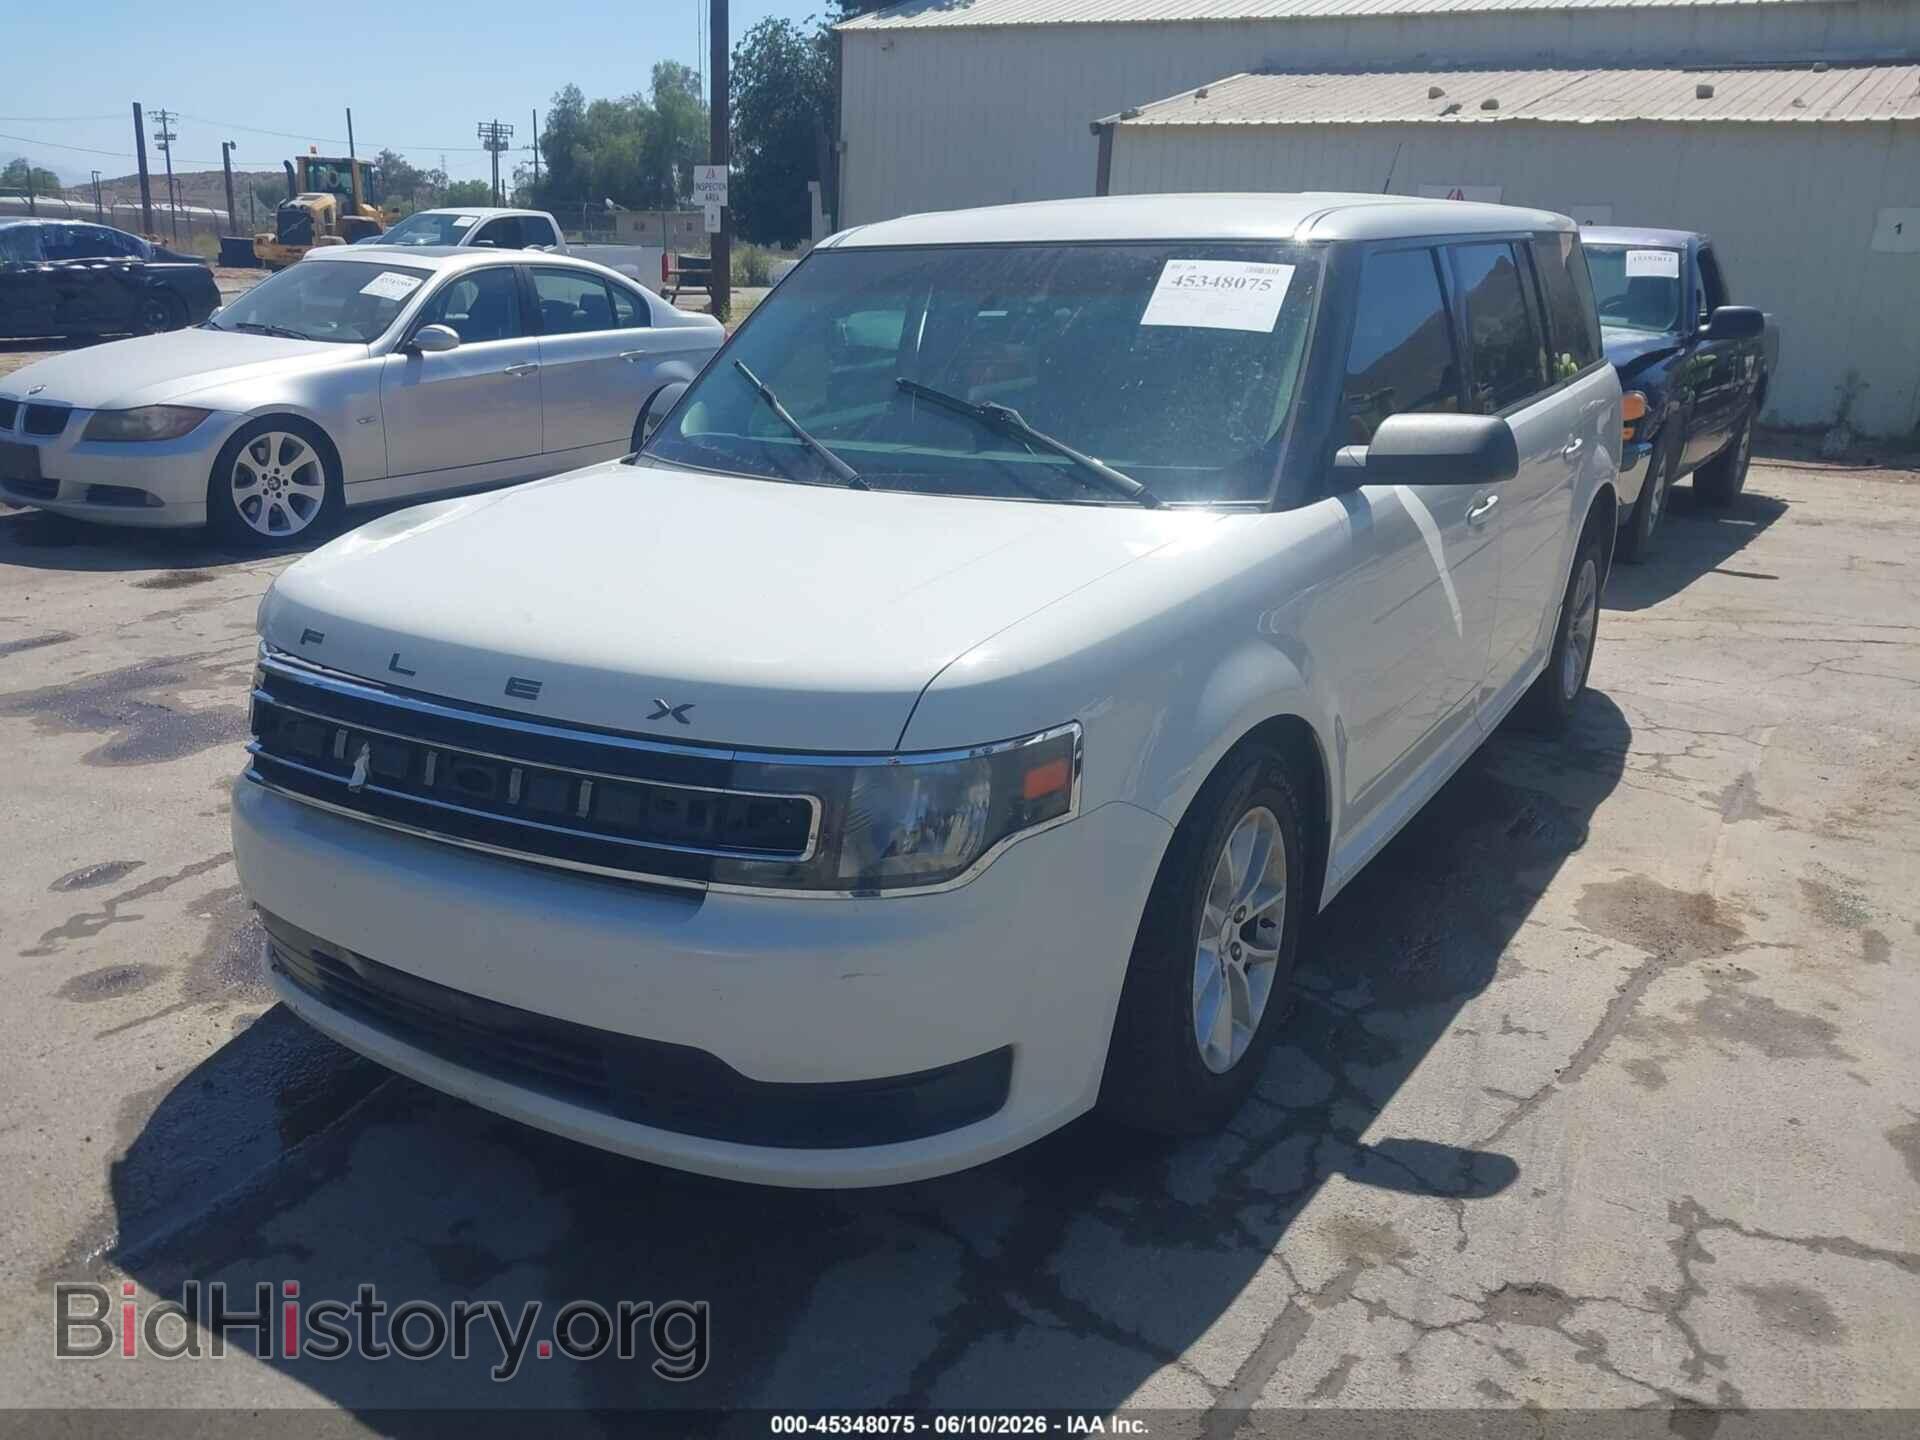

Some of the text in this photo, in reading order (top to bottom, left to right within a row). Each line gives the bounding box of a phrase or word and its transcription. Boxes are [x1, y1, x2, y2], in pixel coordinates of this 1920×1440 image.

[1894, 222, 1903, 235] 1
[1171, 275, 1273, 291] 45348075
[301, 628, 696, 725] FLEX
